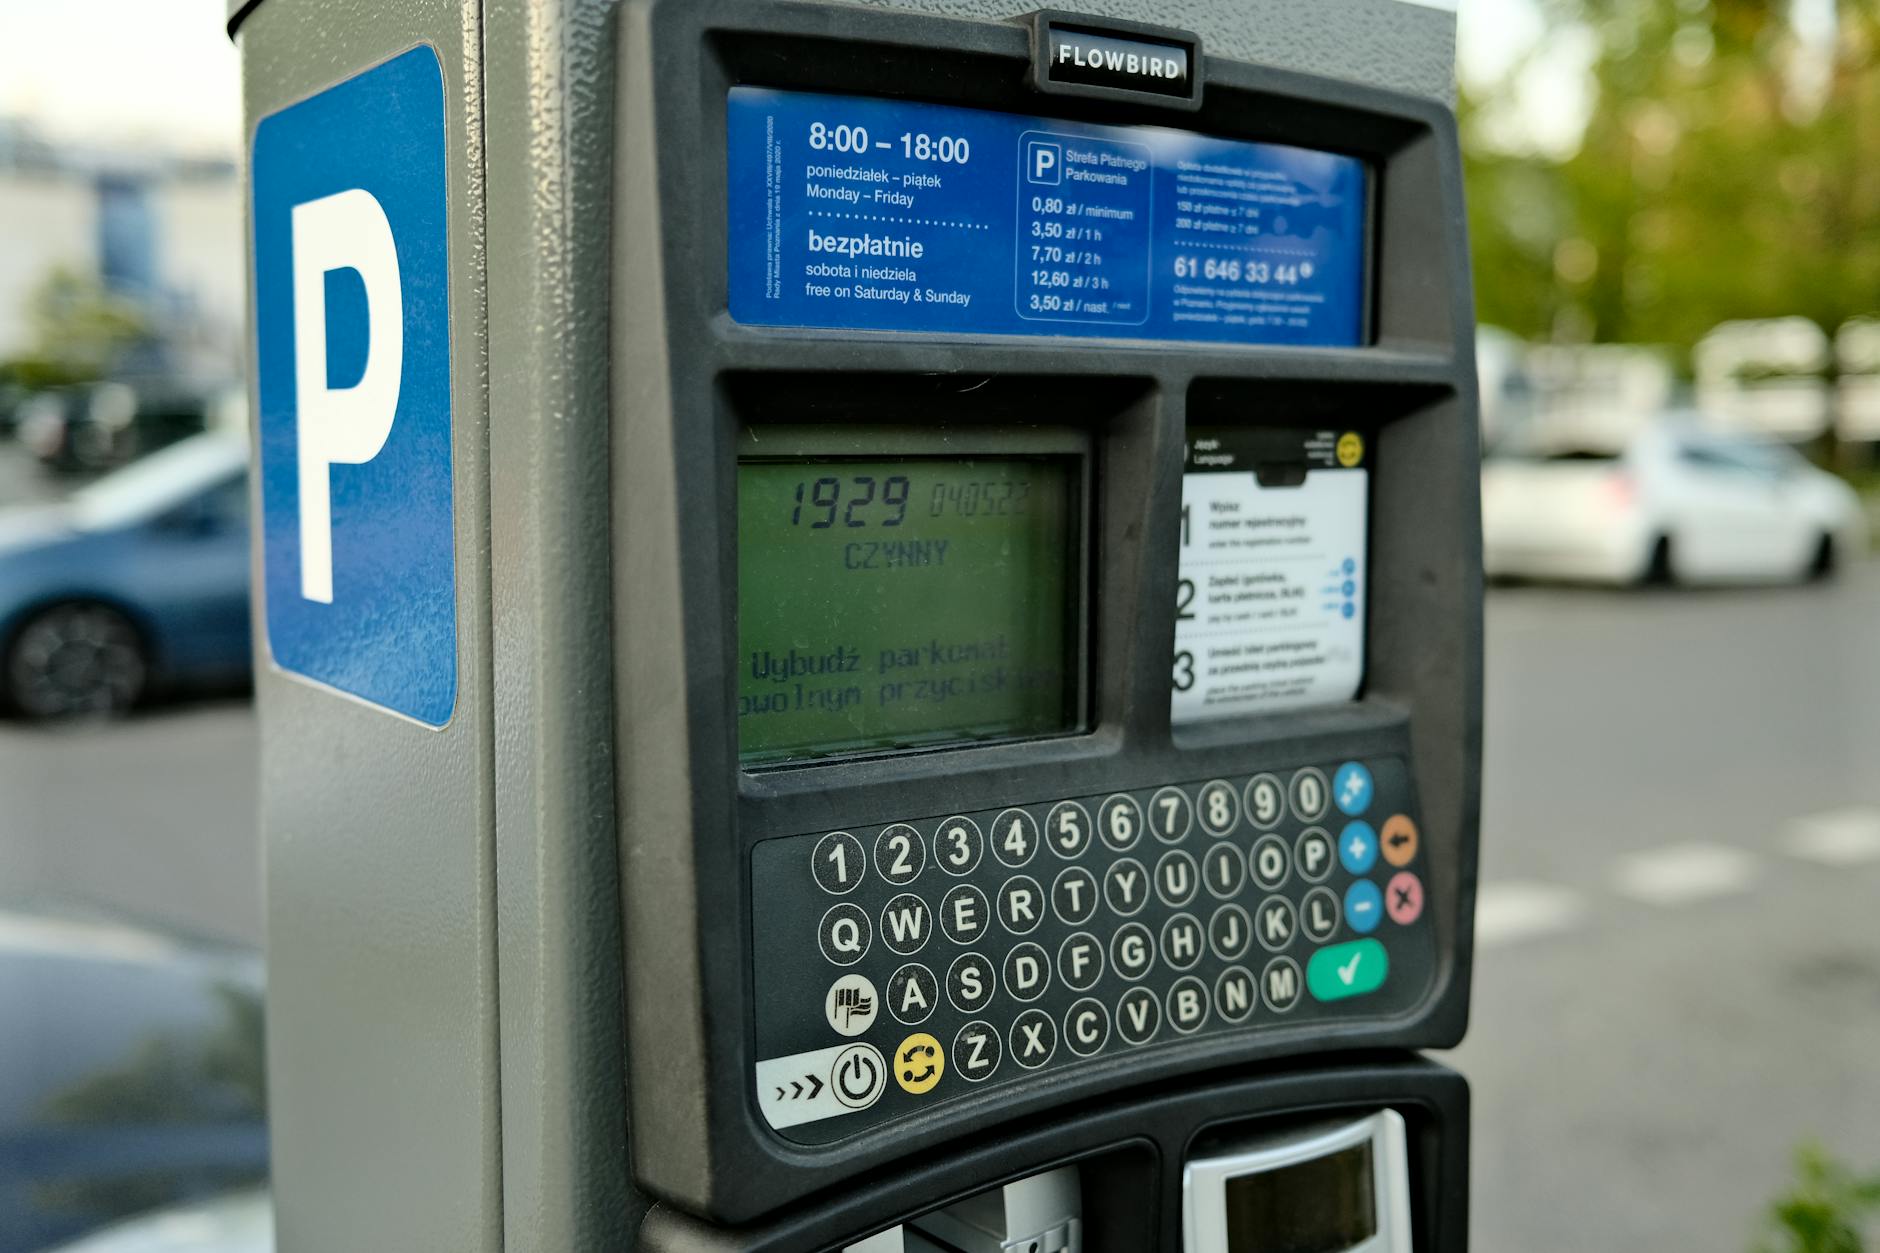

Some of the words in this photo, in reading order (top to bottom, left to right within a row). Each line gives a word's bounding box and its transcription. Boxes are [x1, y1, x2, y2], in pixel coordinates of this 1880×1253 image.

[1059, 44, 1179, 79] FLOWBIRD
[809, 121, 869, 154] 8:00
[900, 132, 970, 164] 18:00
[1066, 150, 1098, 165] Strefa
[806, 164, 889, 183] poniedziałek
[903, 173, 942, 188] piątek
[1036, 149, 1055, 178] P
[1066, 167, 1128, 185] Parkowania
[806, 184, 860, 203] Monday
[875, 189, 914, 208] Friday
[1032, 197, 1062, 215] 0,80
[1066, 203, 1077, 215] zł
[1085, 205, 1134, 220] minimum
[808, 229, 924, 259] bezpłatnie
[1032, 221, 1062, 239] 3,50
[1065, 227, 1076, 239] zł
[1094, 229, 1102, 241] h
[1031, 245, 1062, 264] 7,70
[1065, 252, 1075, 263] zł
[1084, 253, 1092, 264] 2
[1094, 253, 1102, 265] h
[1173, 255, 1198, 278] 61
[1204, 257, 1241, 282] 646
[1245, 260, 1270, 284] 33
[1274, 264, 1298, 285] 44
[805, 262, 851, 278] sobota
[854, 265, 859, 278] i
[861, 266, 917, 282] niedziela
[1031, 270, 1069, 289] 12,60
[1073, 276, 1083, 288] zł
[1092, 277, 1099, 289] 3
[1101, 277, 1109, 289] h
[805, 282, 831, 297] free
[834, 286, 851, 298] on
[854, 284, 910, 304] Saturday
[913, 289, 922, 302] &
[925, 290, 971, 307] Sunday
[1030, 294, 1060, 313] 3,50
[1063, 299, 1074, 311] zł
[291, 188, 404, 605] P
[792, 476, 911, 529] 1929
[844, 540, 949, 570] CZYNNY
[1176, 579, 1195, 620] 2
[1172, 650, 1195, 691] 3
[828, 843, 847, 883] 1
[888, 835, 912, 875] 2
[948, 827, 970, 865] 3
[1004, 819, 1027, 857] 4
[1059, 811, 1080, 849] 5
[1110, 804, 1133, 841] 6
[1160, 797, 1179, 834] 7
[1209, 790, 1229, 827] 8
[1254, 783, 1276, 820] 9
[1300, 776, 1321, 813] 0
[832, 917, 861, 953] Q
[889, 906, 923, 942] W
[954, 898, 977, 931] E
[1010, 889, 1034, 922] R
[1064, 880, 1084, 912] T
[1114, 871, 1137, 903] Y
[1165, 863, 1188, 895] U
[1220, 854, 1231, 886] I
[1259, 847, 1283, 879] O
[1305, 840, 1326, 872] P
[901, 978, 928, 1013] A
[960, 966, 982, 1000] S
[1015, 957, 1039, 990] D
[1071, 945, 1090, 978] F
[1121, 935, 1145, 968] G
[1172, 925, 1194, 958] H
[1222, 916, 1239, 948] J
[1265, 906, 1289, 940] K
[1311, 901, 1331, 931] L
[967, 1034, 990, 1070] Z
[1022, 1022, 1046, 1056] X
[1076, 1011, 1098, 1043] C
[1126, 1000, 1149, 1032] V
[1177, 989, 1200, 1022] B
[1224, 978, 1248, 1012] N
[1270, 967, 1295, 1001] M
